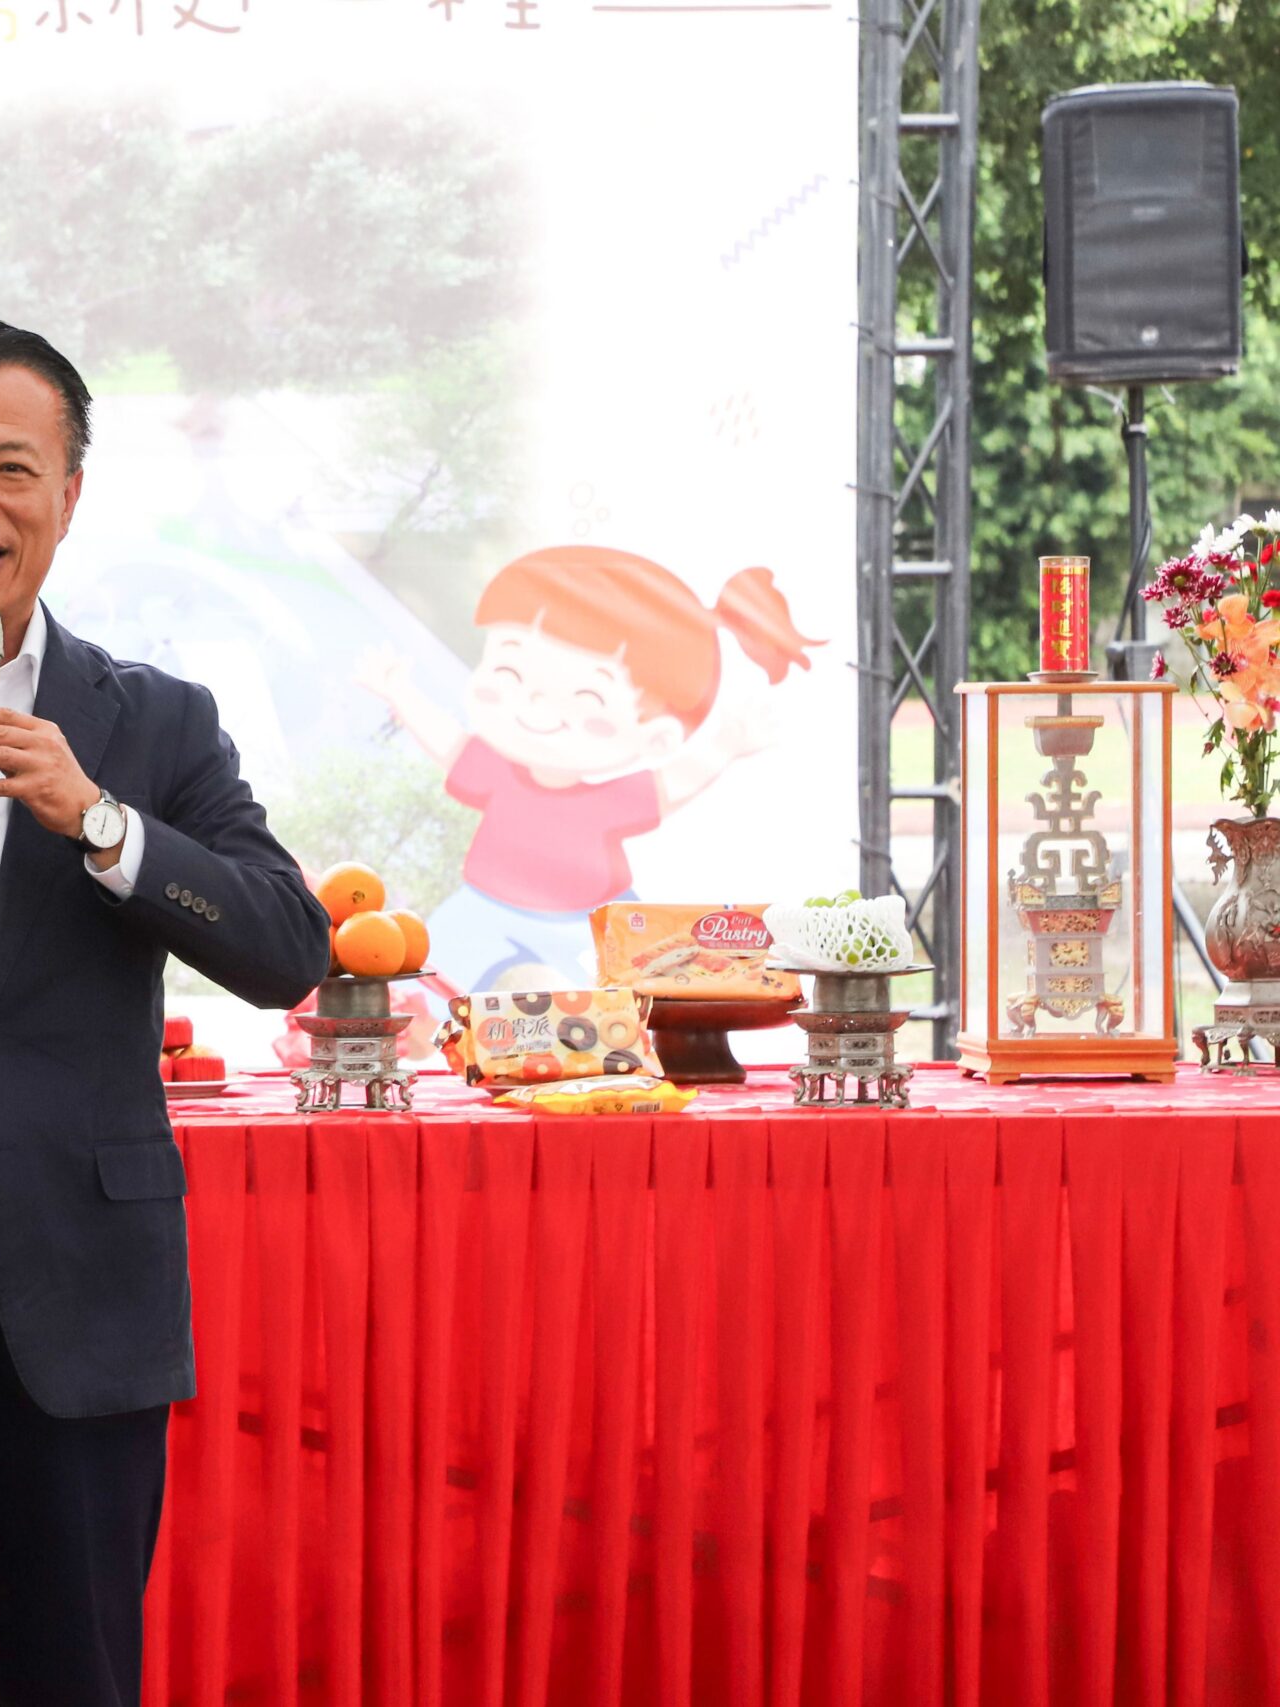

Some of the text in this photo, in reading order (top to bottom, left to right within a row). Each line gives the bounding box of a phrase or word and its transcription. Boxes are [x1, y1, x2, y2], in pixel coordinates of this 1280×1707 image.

[698, 914, 768, 948] Pastry
[730, 915, 752, 927] Puff
[487, 1015, 553, 1041] 新貴派
